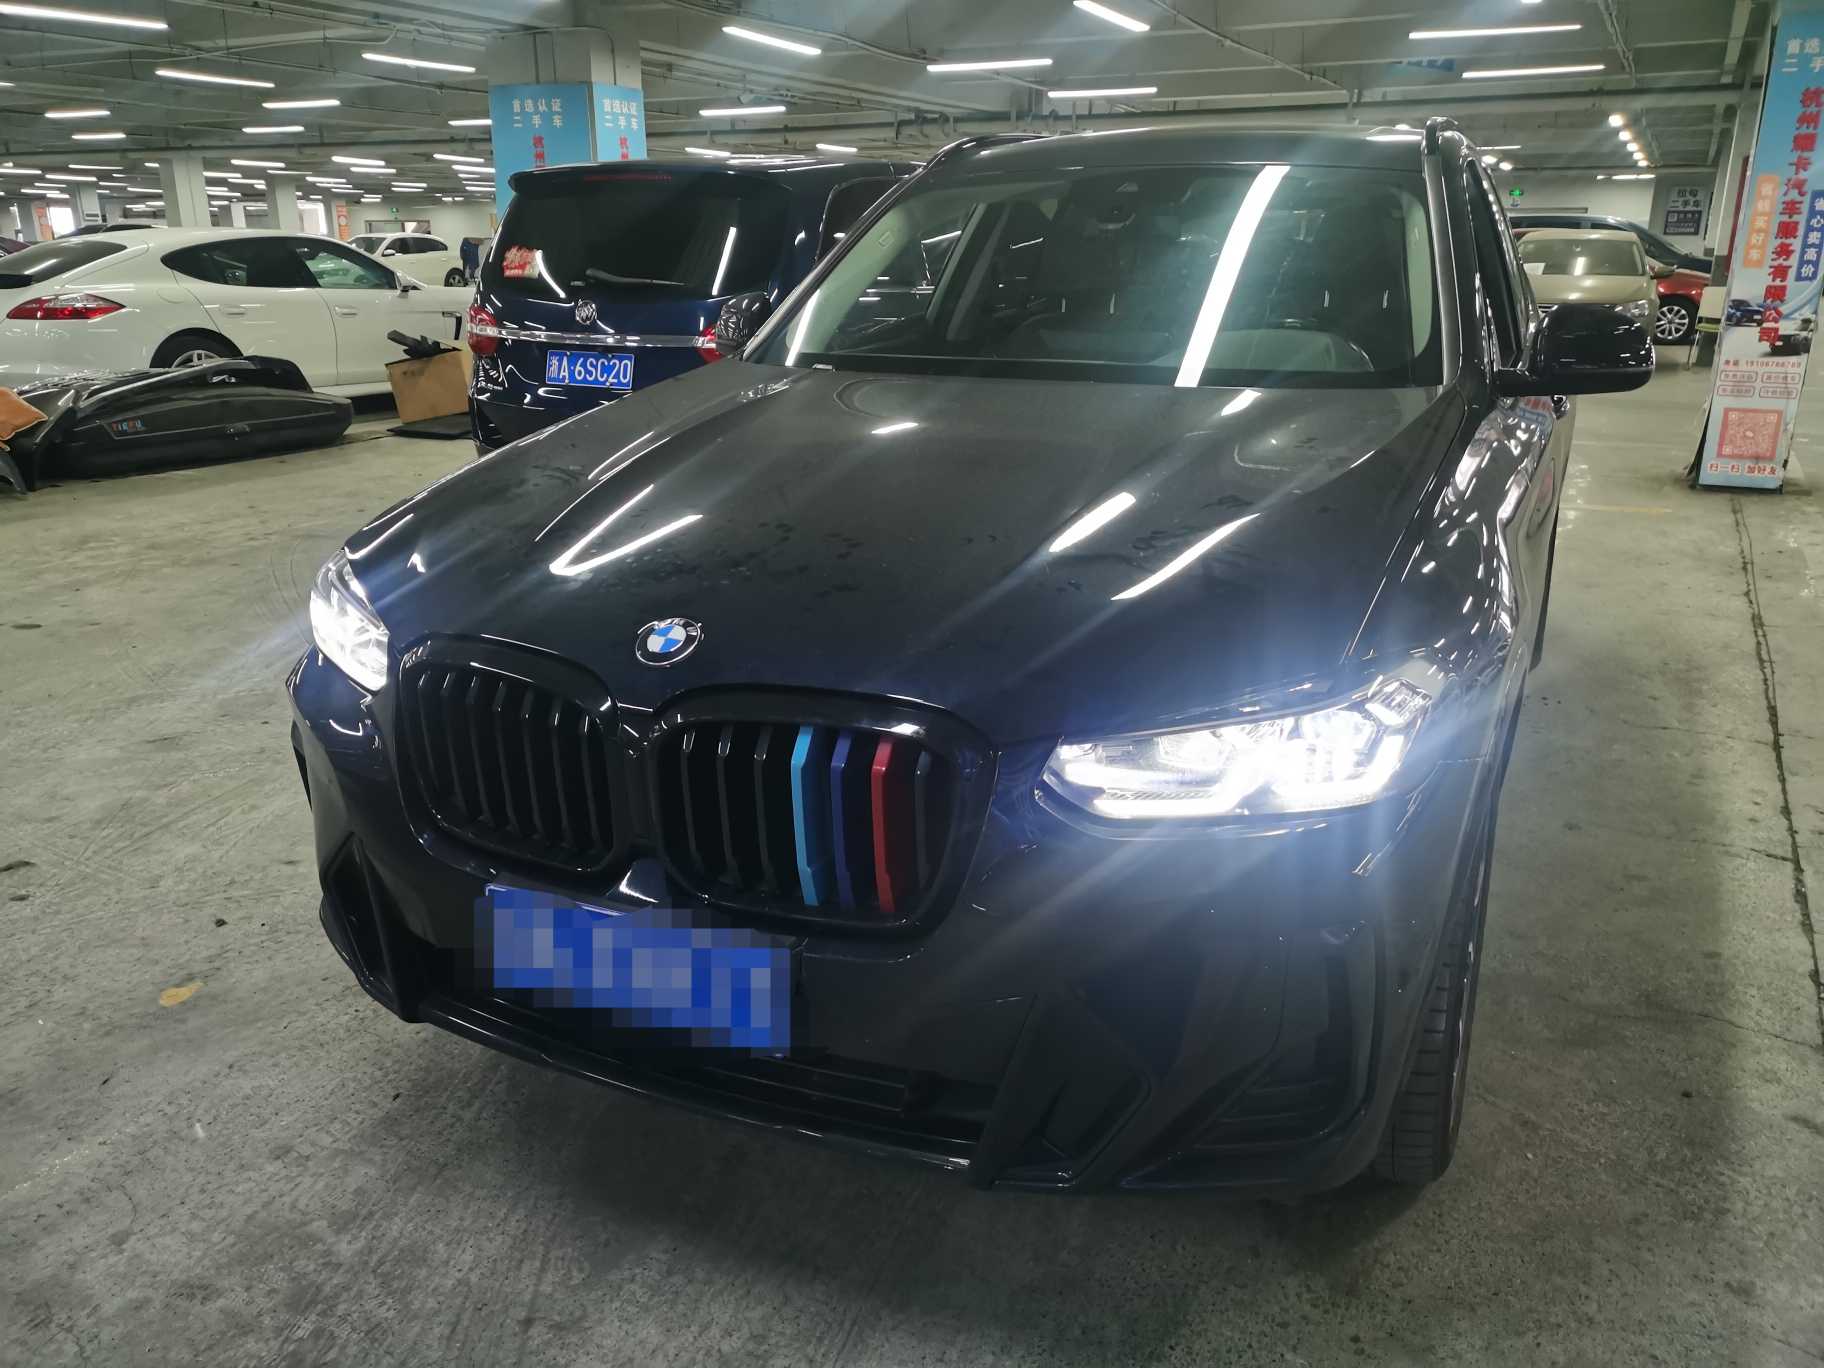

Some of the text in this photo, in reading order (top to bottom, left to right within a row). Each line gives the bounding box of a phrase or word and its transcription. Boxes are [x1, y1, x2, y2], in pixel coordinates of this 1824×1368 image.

[512, 97, 562, 112] 首选认证
[513, 114, 564, 128] 二手车
[603, 115, 639, 131] 二手车
[1709, 463, 1740, 473] 扫一扫
